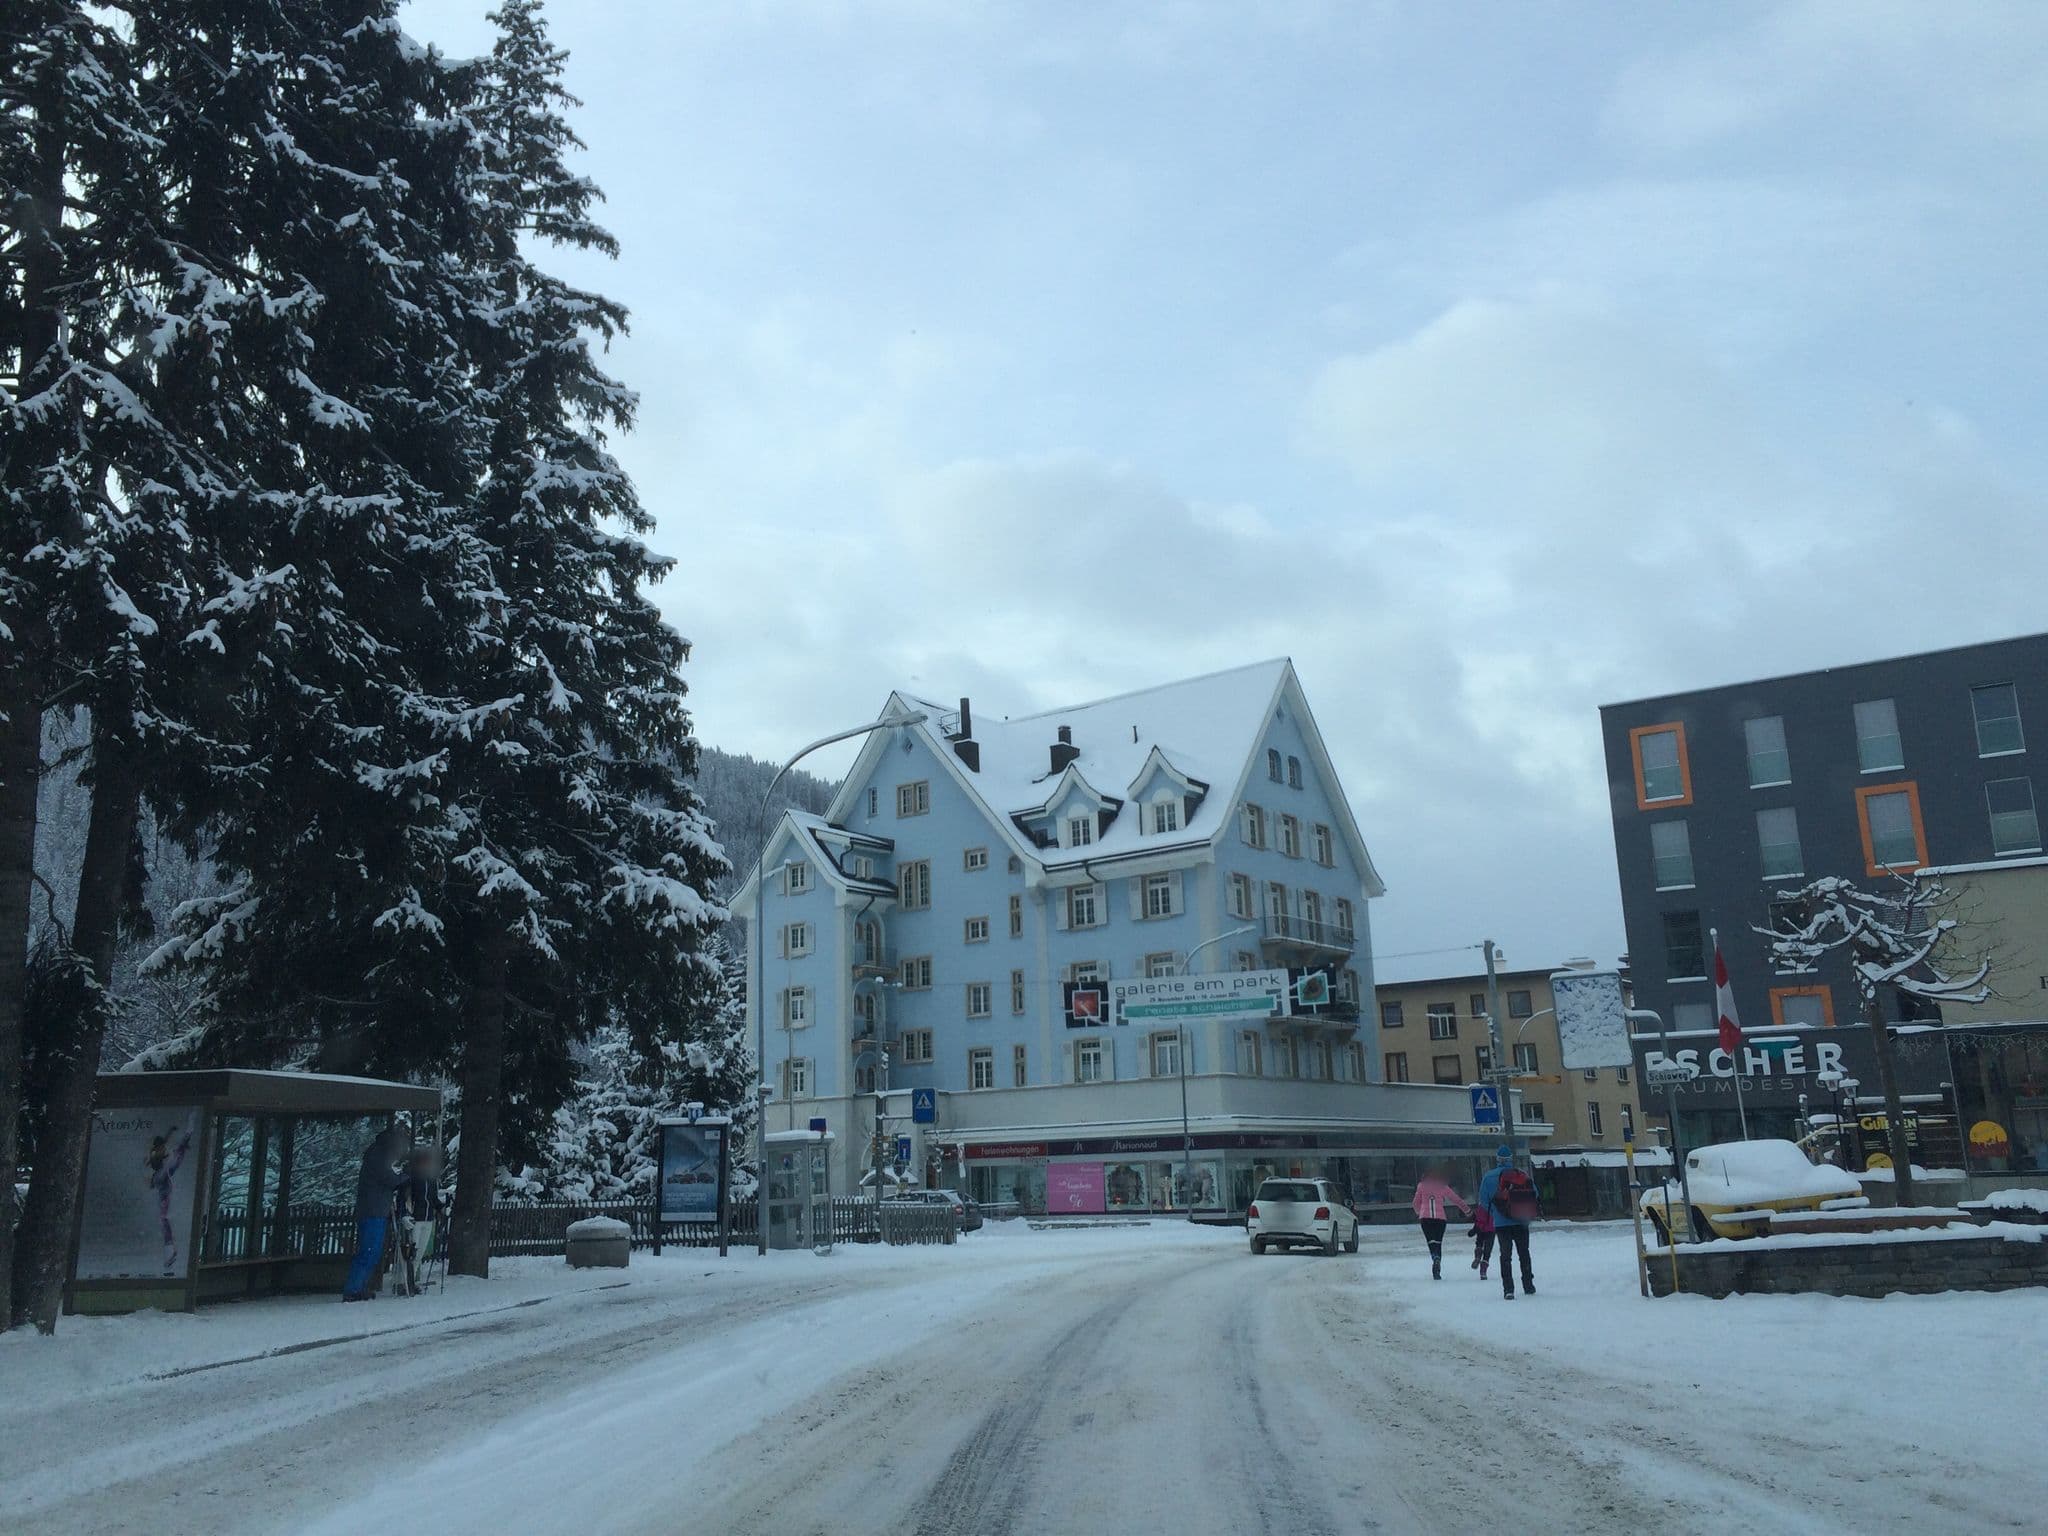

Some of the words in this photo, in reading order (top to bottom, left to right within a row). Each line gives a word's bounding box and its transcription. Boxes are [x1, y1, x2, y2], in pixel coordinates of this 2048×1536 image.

[1115, 983, 1185, 998] galerie
[1194, 980, 1224, 992] am
[1233, 973, 1281, 991] park
[1645, 1042, 1849, 1079] ESCHER
